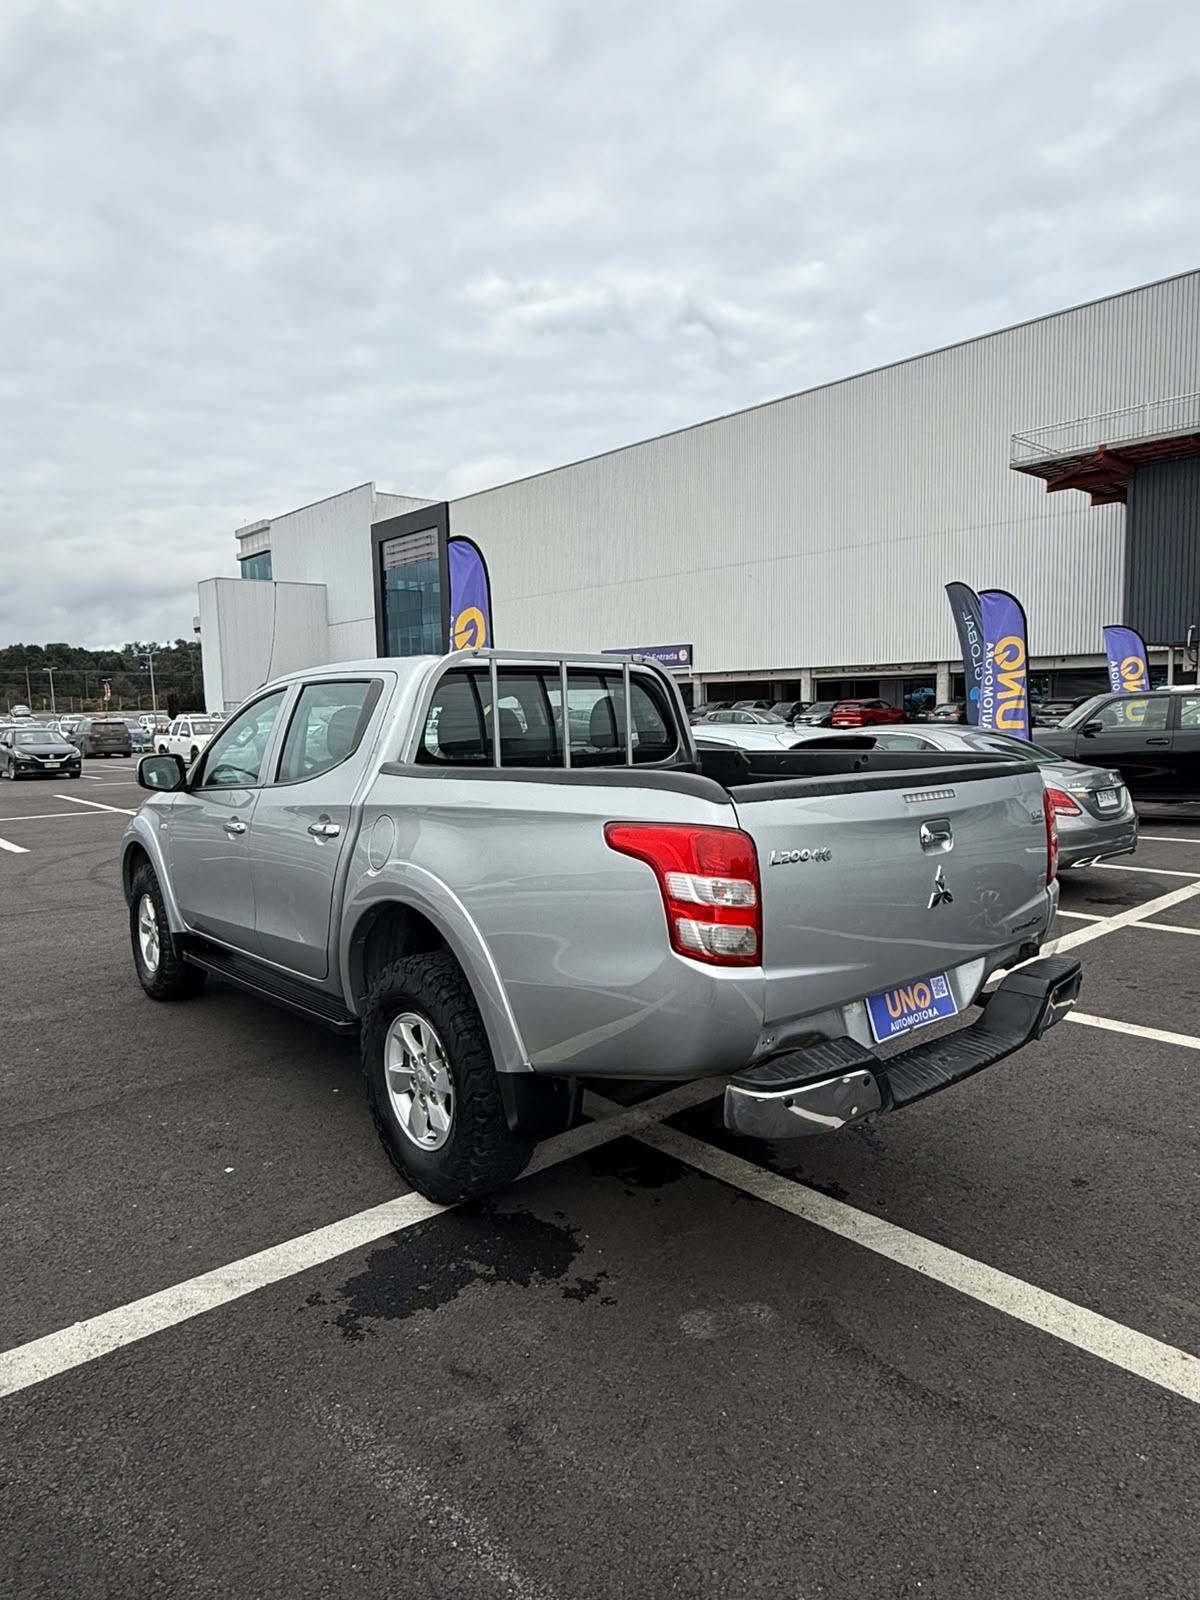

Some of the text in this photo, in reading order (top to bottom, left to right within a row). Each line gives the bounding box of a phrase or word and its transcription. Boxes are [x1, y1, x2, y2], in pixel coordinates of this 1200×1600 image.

[768, 849, 811, 866] L200
[884, 982, 931, 1018] UNO
[890, 1006, 940, 1033] AUTOMOTORA
